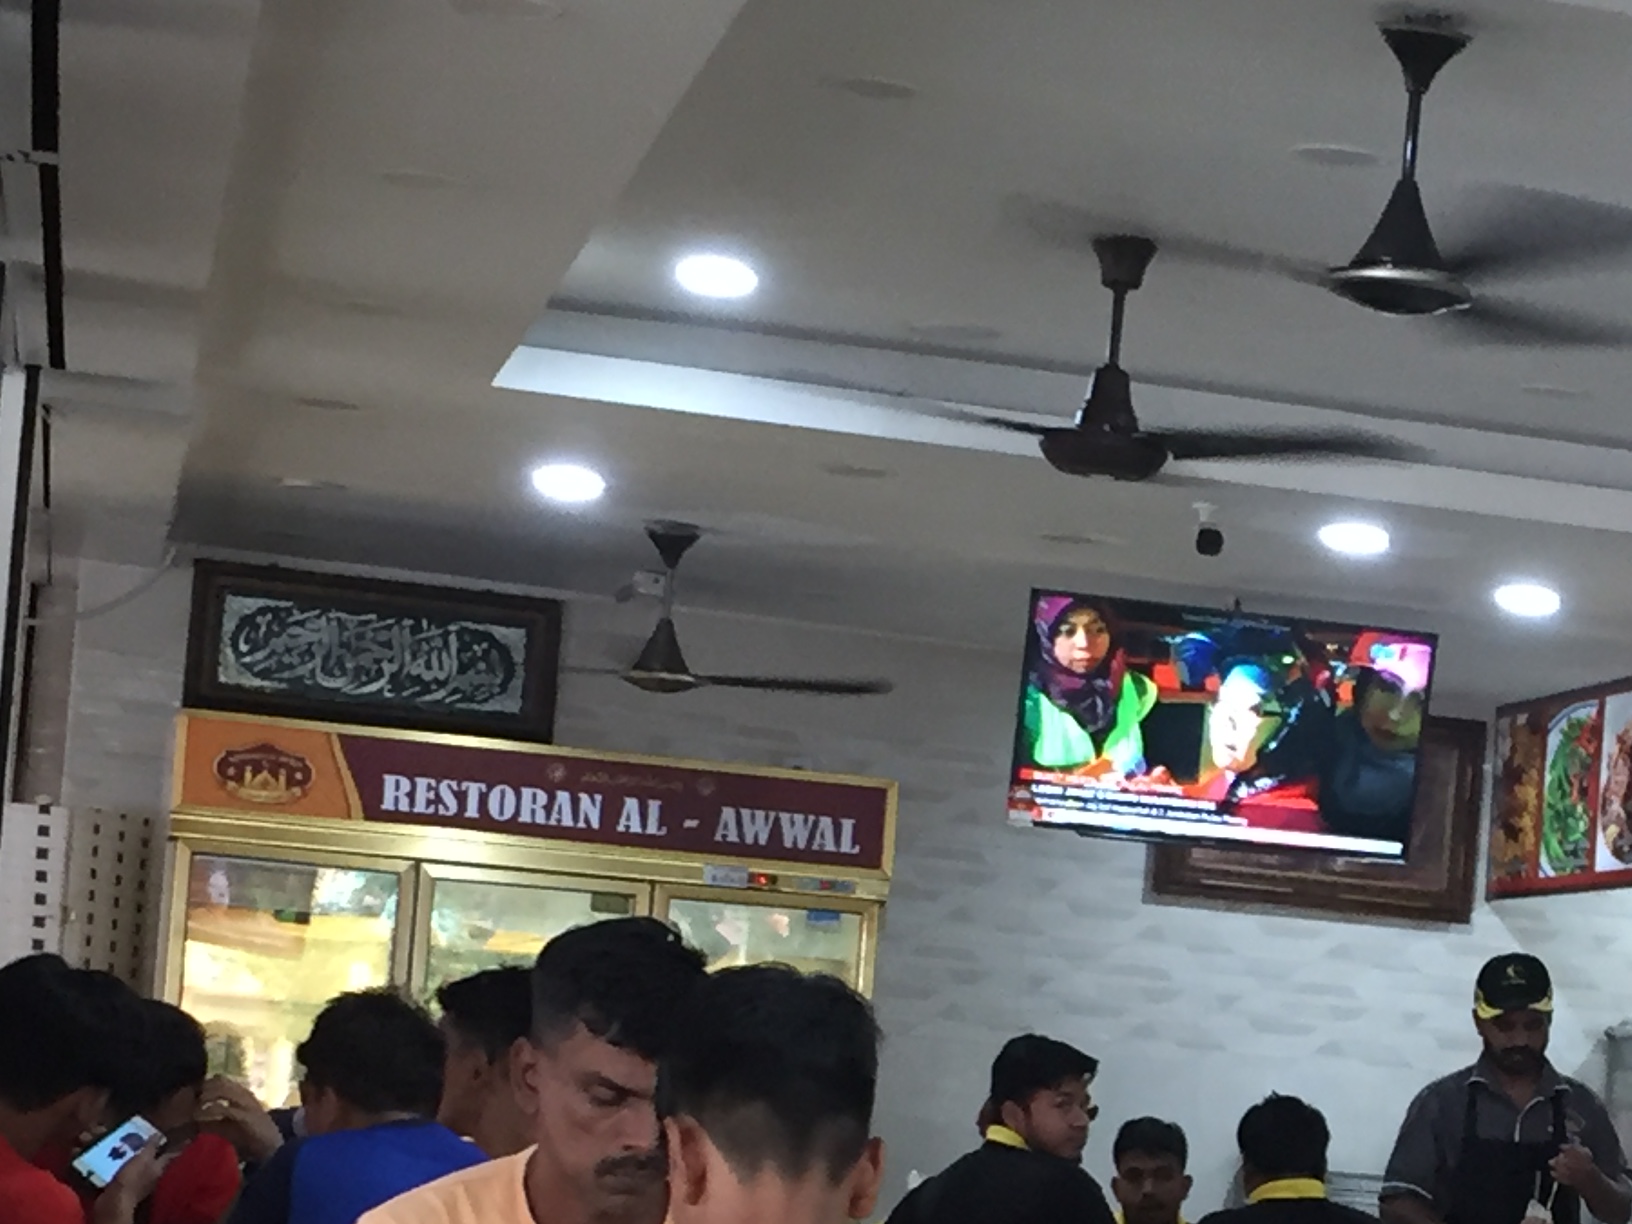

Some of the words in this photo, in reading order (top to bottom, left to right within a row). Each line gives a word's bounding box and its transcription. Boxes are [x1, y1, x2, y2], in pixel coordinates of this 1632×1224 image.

[380, 774, 603, 829] RESTORAN
[616, 797, 667, 836] AL
[714, 805, 861, 855] AWWAL
